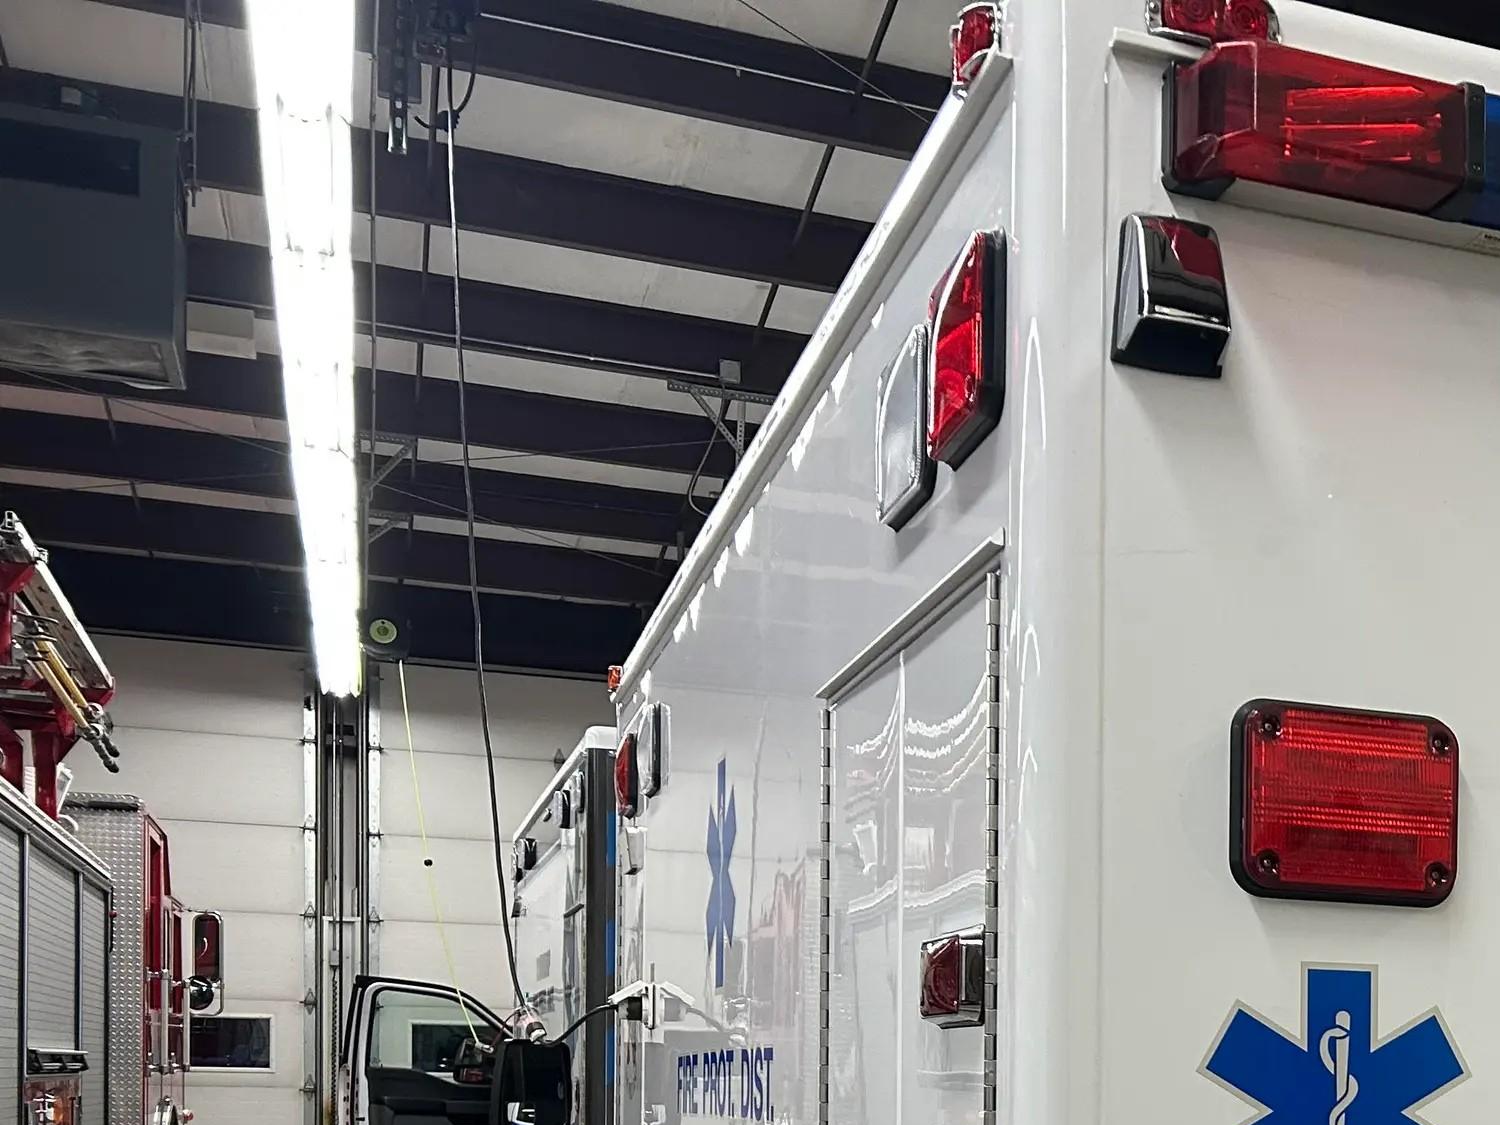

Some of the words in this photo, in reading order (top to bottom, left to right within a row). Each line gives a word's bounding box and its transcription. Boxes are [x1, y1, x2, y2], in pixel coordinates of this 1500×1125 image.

[677, 1054, 698, 1114] FIRE
[703, 1049, 735, 1118] PROT.
[741, 1046, 774, 1122] DIST.
